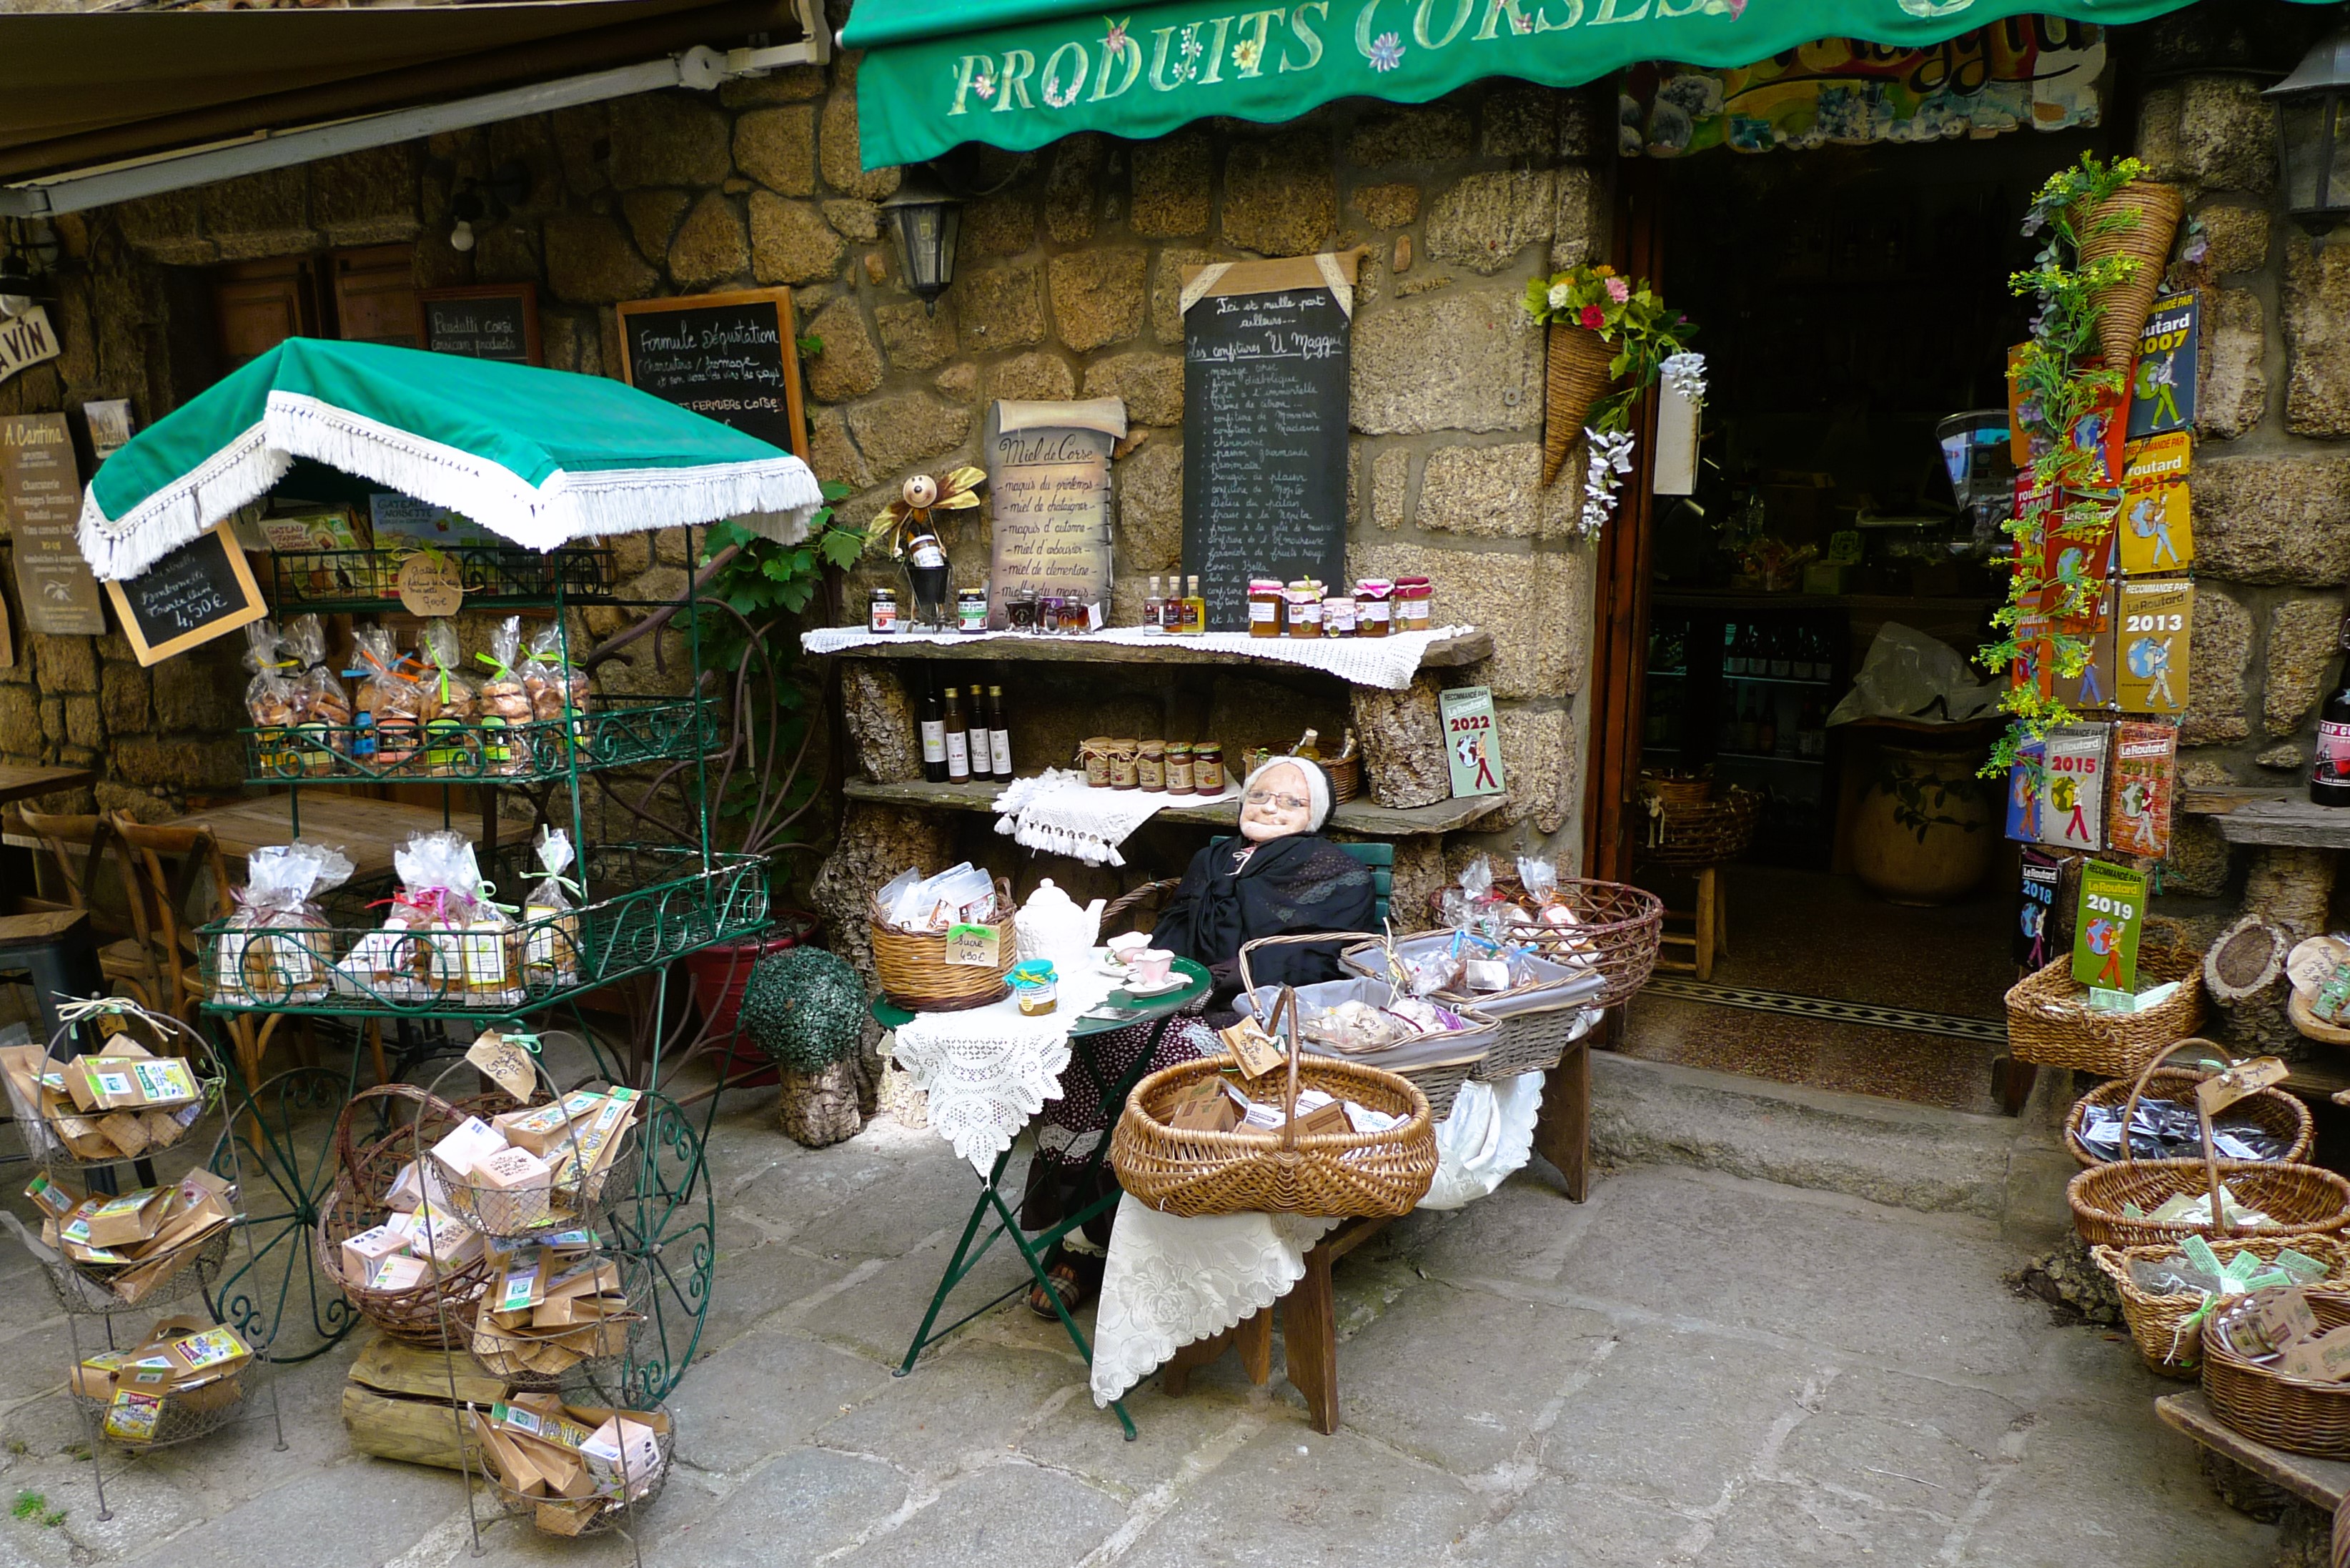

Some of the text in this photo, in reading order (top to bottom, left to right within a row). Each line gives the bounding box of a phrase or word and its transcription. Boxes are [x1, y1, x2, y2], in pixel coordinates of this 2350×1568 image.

[946, 0, 1714, 116] PRODUITS CORS
[1216, 297, 1239, 314] Ici
[1243, 298, 1259, 311] et
[1299, 296, 1326, 312] part
[2151, 294, 2193, 312] MANDÉ PAR
[2138, 312, 2190, 339] utard
[641, 321, 697, 352] Formule
[2134, 329, 2188, 357] 2007
[1187, 336, 1206, 358] Les
[1212, 341, 1261, 362] confitures
[705, 356, 760, 377] fromage
[999, 434, 1093, 465] Miel de Corse
[2171, 436, 2185, 447] PAR
[2128, 455, 2182, 477] routard
[1006, 475, 1094, 497] maquis du printemps
[2018, 484, 2054, 502] rouard
[1011, 497, 1029, 512] miel
[1034, 497, 1043, 512] de
[1008, 521, 1040, 540] maquis
[1013, 540, 1034, 555] miel
[1008, 559, 1029, 575] miel
[1032, 560, 1042, 575] de
[1038, 582, 1050, 597] du
[2175, 582, 2188, 592] PAR
[2126, 614, 2182, 632] 2013
[1450, 715, 1490, 732] 2022
[2051, 756, 2096, 773] 2015
[2121, 759, 2164, 779] 2016
[2023, 880, 2052, 904] 2018
[2086, 894, 2133, 920] 2019
[953, 933, 983, 948] Sucre
